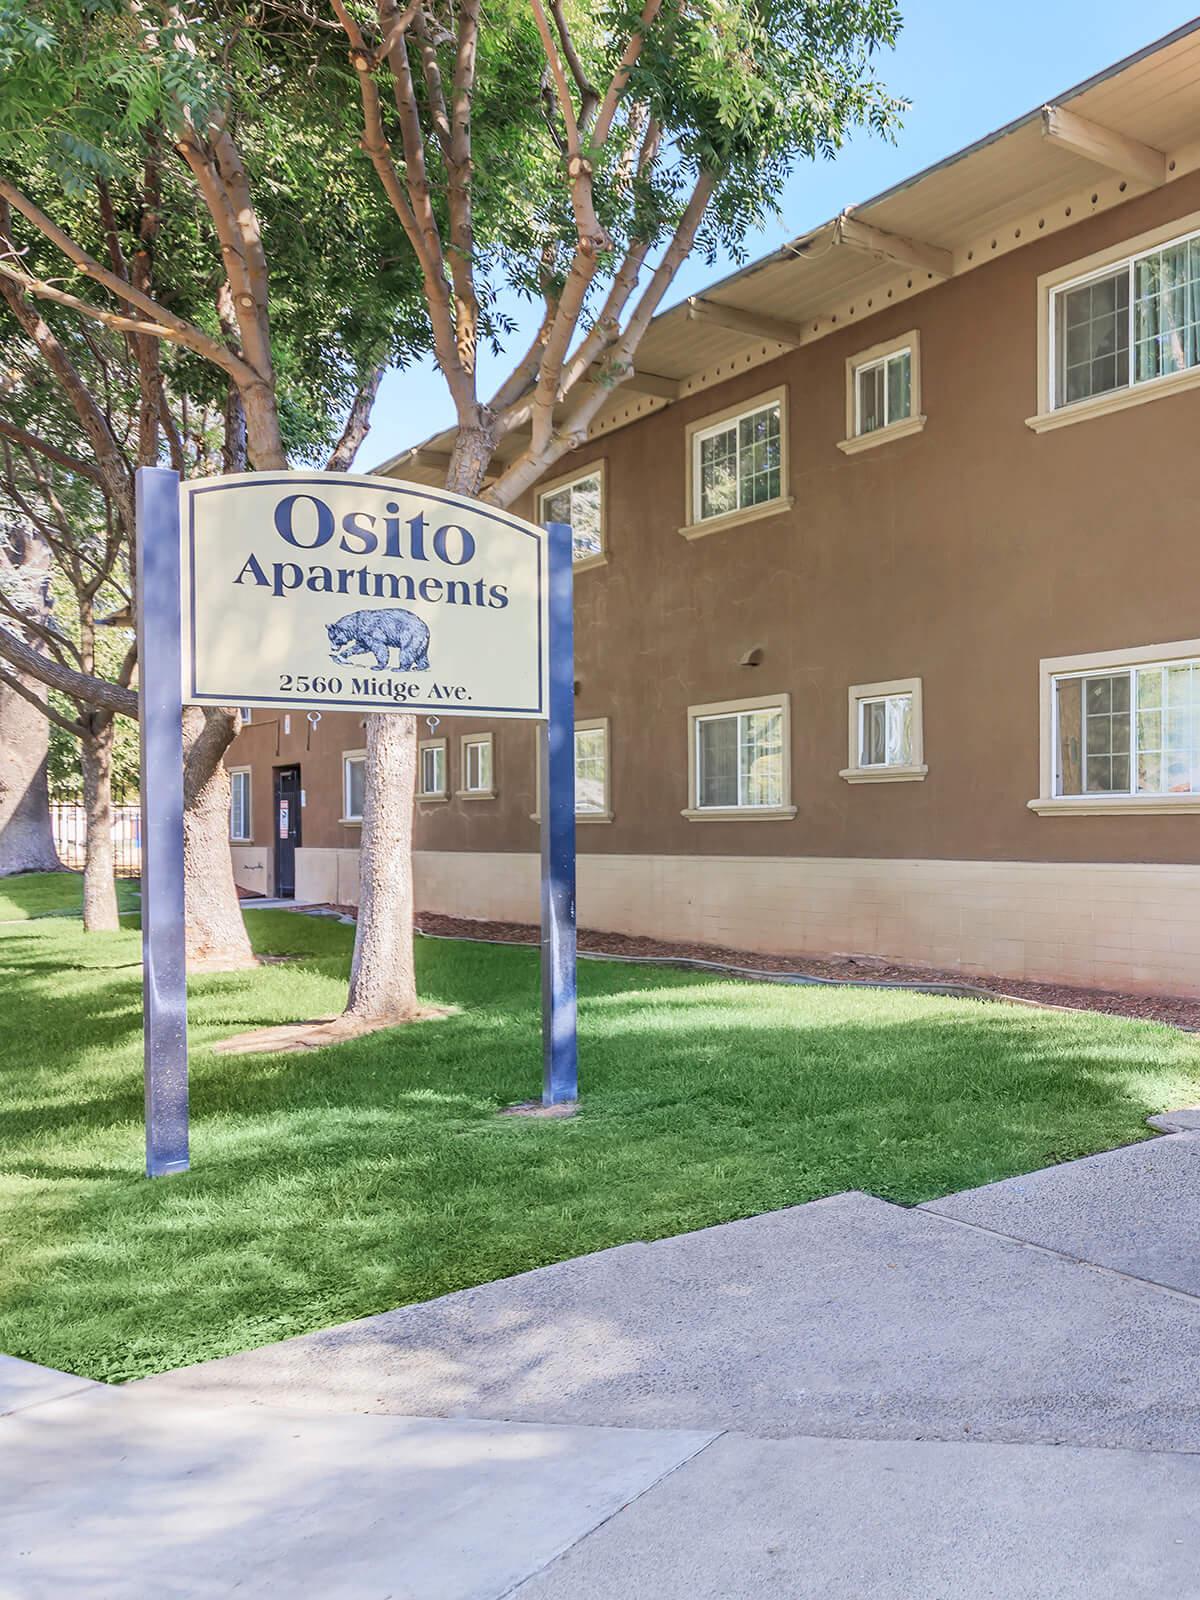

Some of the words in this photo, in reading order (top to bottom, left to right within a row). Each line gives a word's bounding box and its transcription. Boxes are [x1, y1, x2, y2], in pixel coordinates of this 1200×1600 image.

[274, 494, 476, 566] Osito
[233, 552, 510, 609] Apartments
[279, 674, 343, 695] 2560
[351, 677, 420, 702] Midge
[428, 682, 473, 701] Ave.
